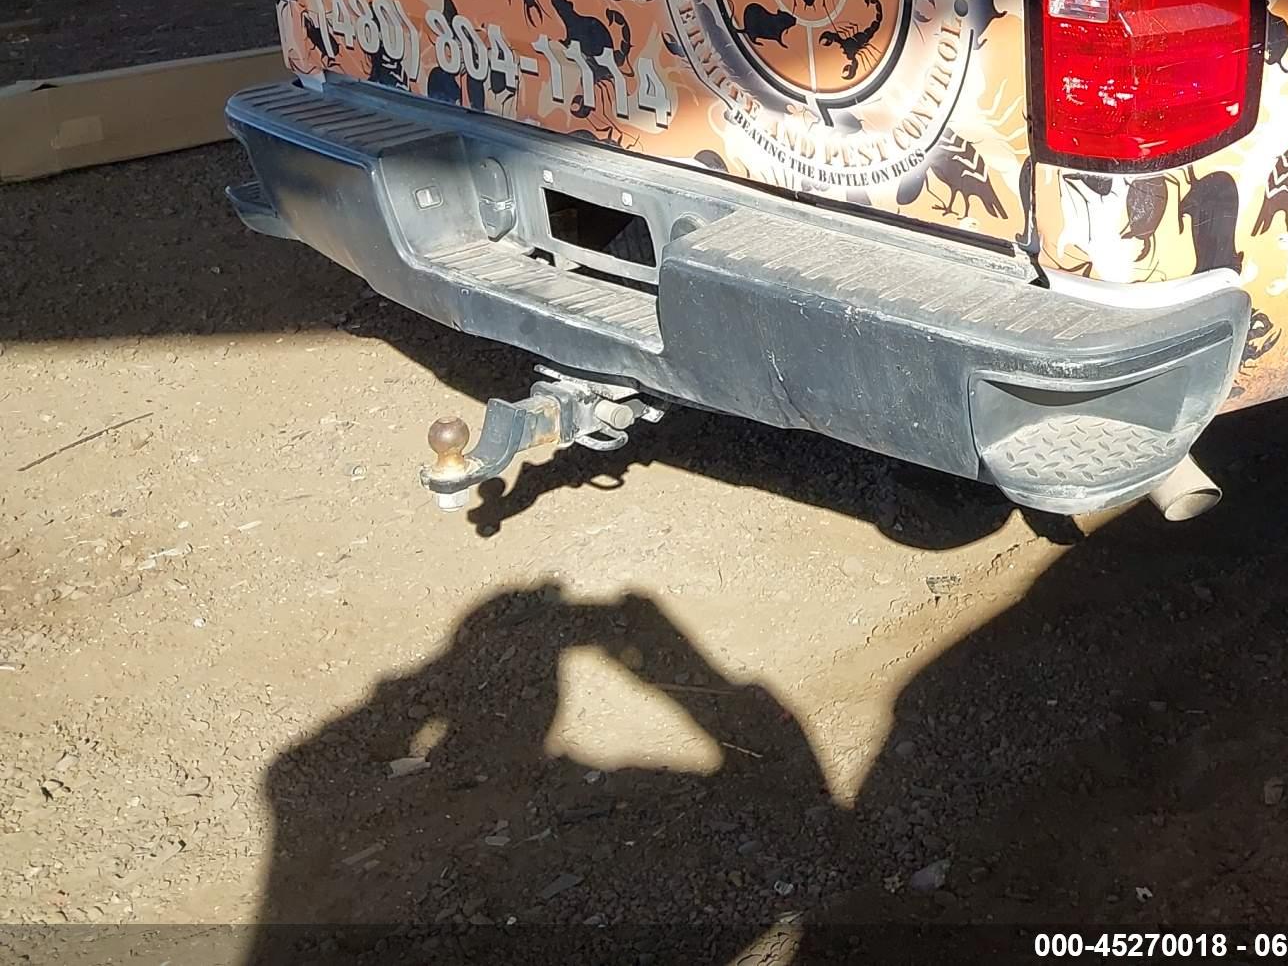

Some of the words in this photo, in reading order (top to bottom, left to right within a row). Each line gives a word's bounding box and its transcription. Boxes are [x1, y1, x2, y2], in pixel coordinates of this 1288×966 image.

[425, 9, 672, 130] 804-1114
[764, 120, 816, 160] AND
[824, 137, 889, 168] PEST
[892, 16, 963, 151] CONTROL
[733, 109, 786, 164] BEATING
[789, 155, 815, 179] THE
[818, 169, 869, 187] BATTLE
[870, 167, 890, 185] ON
[890, 149, 926, 179] BUGS
